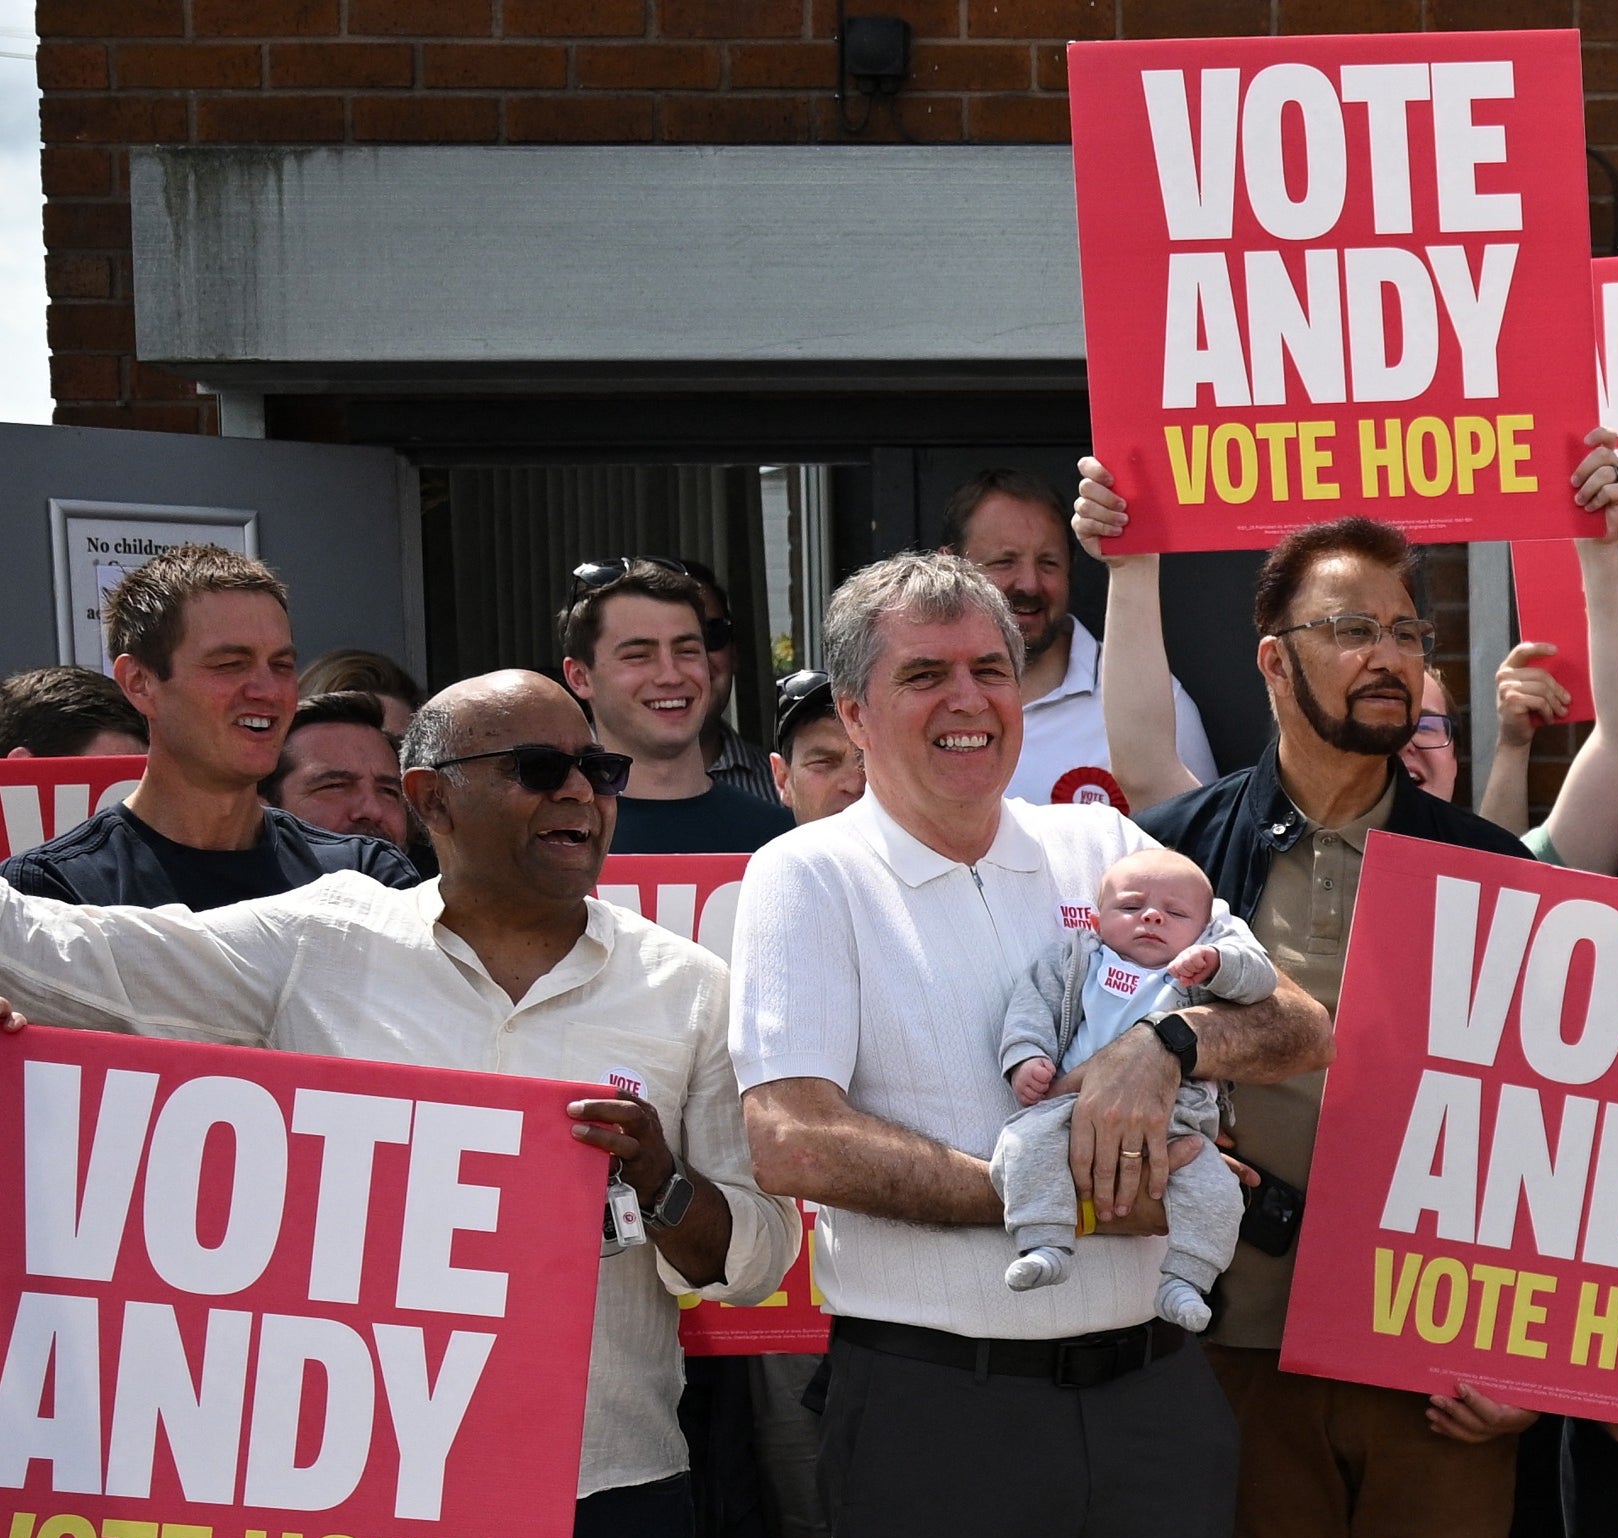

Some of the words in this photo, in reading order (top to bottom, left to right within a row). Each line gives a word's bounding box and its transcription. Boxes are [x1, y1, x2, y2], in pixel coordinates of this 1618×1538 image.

[1141, 60, 1524, 242] VOTE
[1161, 243, 1521, 410] ANDY
[1164, 420, 1340, 505] VOTE
[1359, 413, 1539, 499] HOPE
[87, 537, 110, 554] No
[1081, 790, 1104, 802] VOTE
[1060, 905, 1092, 920] VOTE
[1104, 977, 1138, 995] ANDY
[1108, 966, 1140, 985] VOTE
[609, 1073, 642, 1099] VOTE
[23, 1060, 525, 1319] VOTE
[1371, 1247, 1557, 1359] VOTE
[0, 1291, 498, 1522] ANDY
